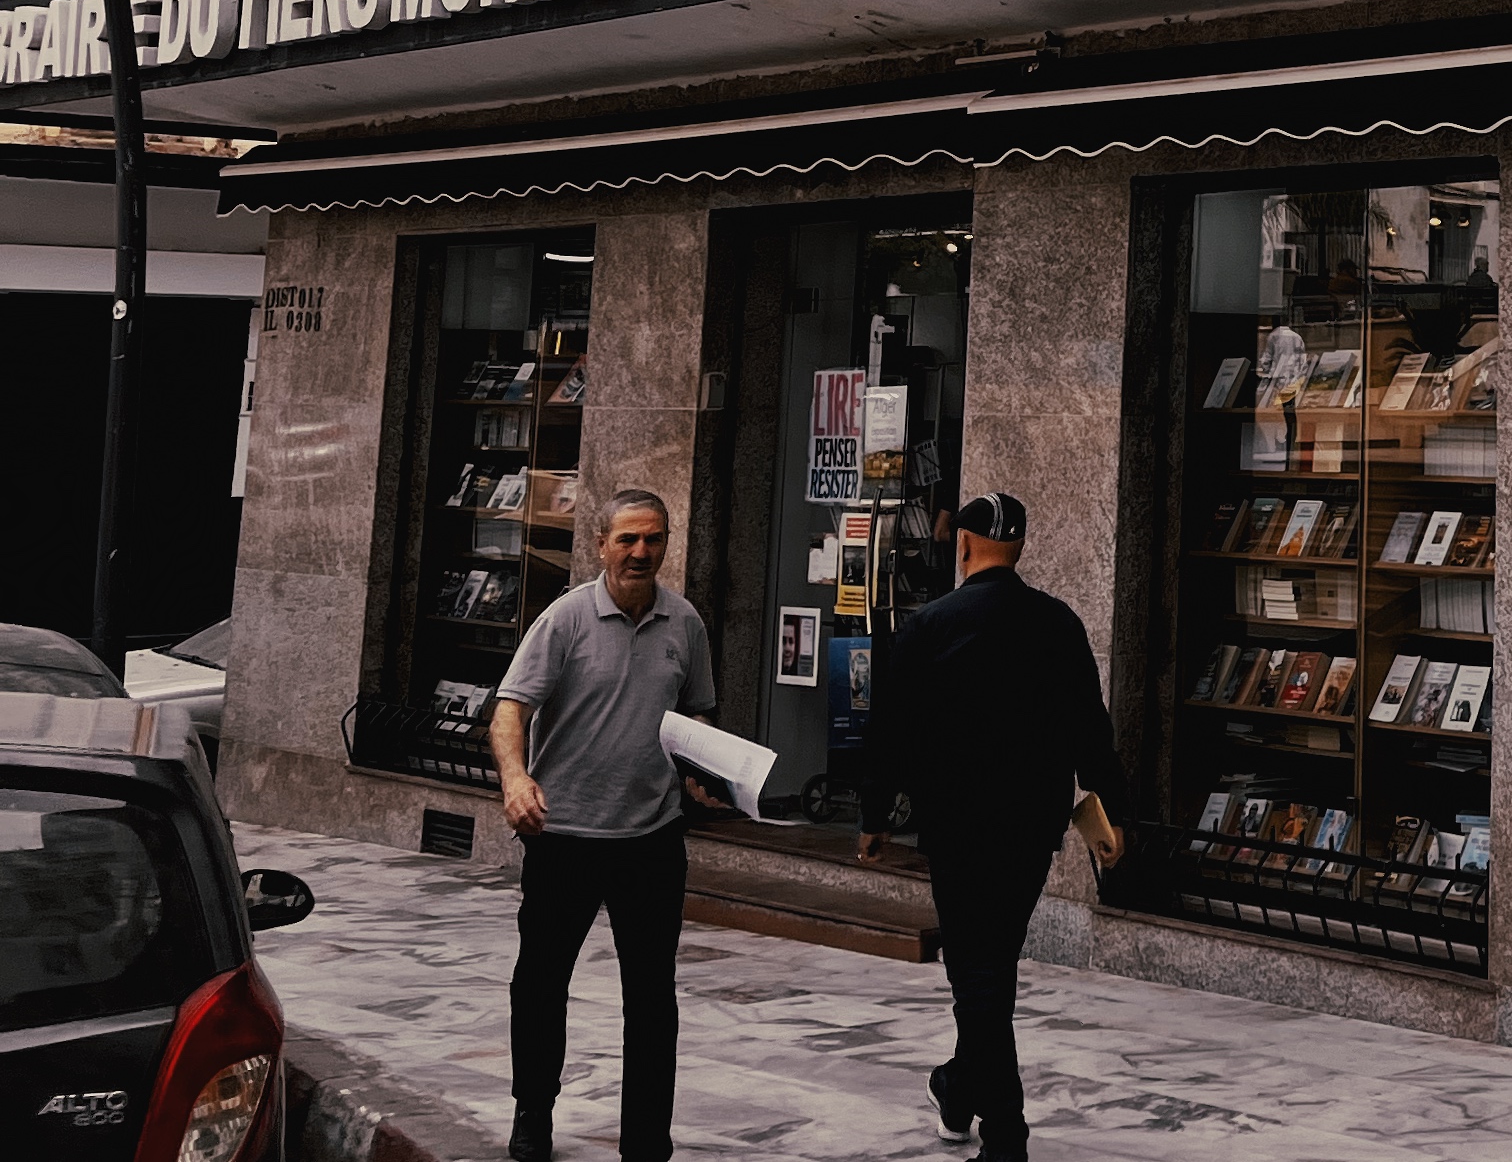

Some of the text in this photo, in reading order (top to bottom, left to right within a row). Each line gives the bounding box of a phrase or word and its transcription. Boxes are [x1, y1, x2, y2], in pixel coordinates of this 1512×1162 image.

[813, 373, 864, 437] LIRE
[814, 438, 858, 468] PENSER
[38, 1090, 128, 1116] ALTO
